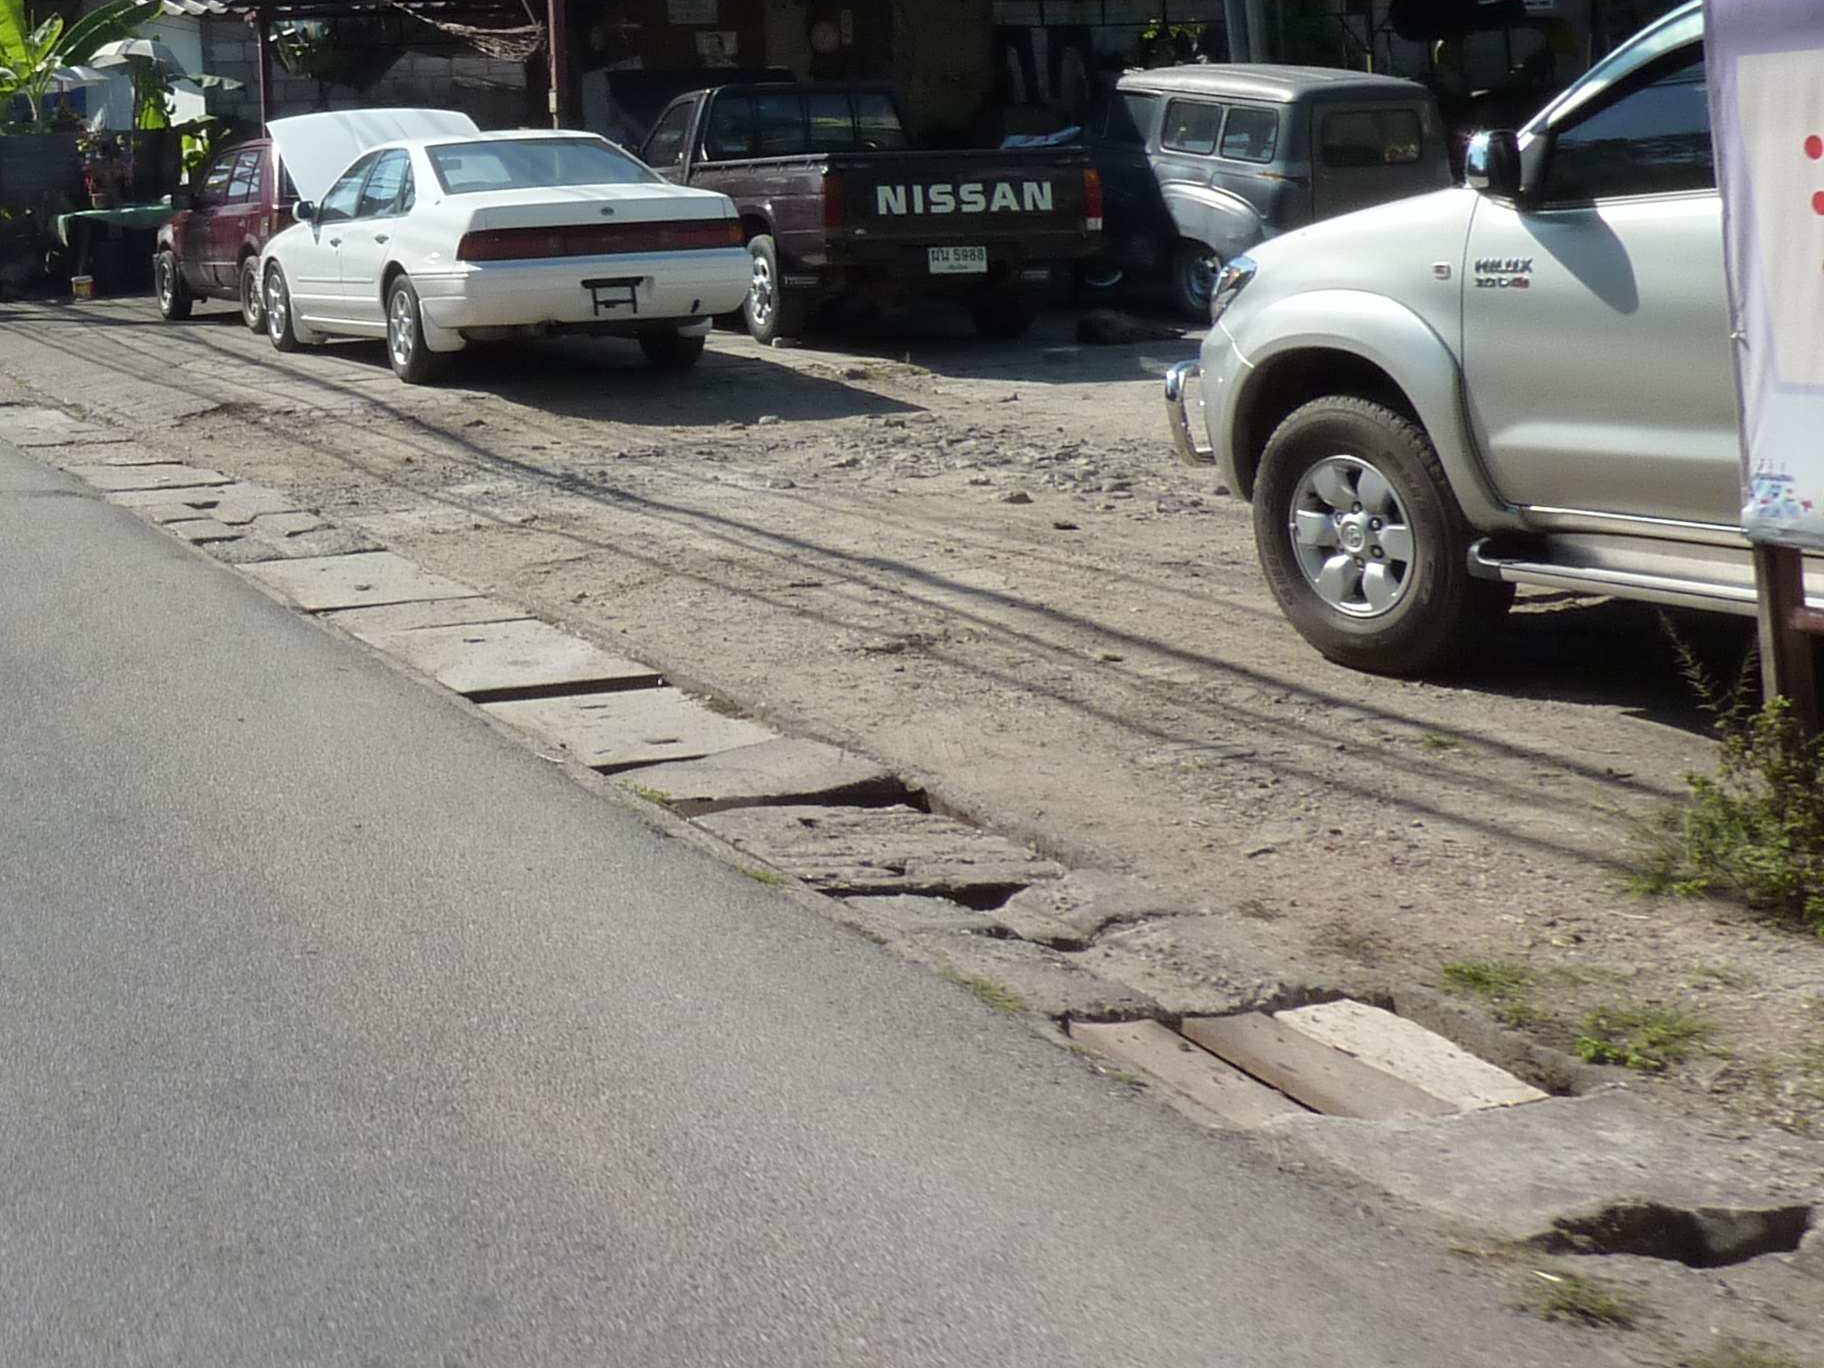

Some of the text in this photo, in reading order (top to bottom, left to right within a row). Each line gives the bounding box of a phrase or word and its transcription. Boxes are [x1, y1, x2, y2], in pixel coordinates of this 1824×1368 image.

[876, 180, 1054, 216] NISSAN
[953, 248, 984, 262] 5988
[1474, 258, 1534, 274] HILUX
